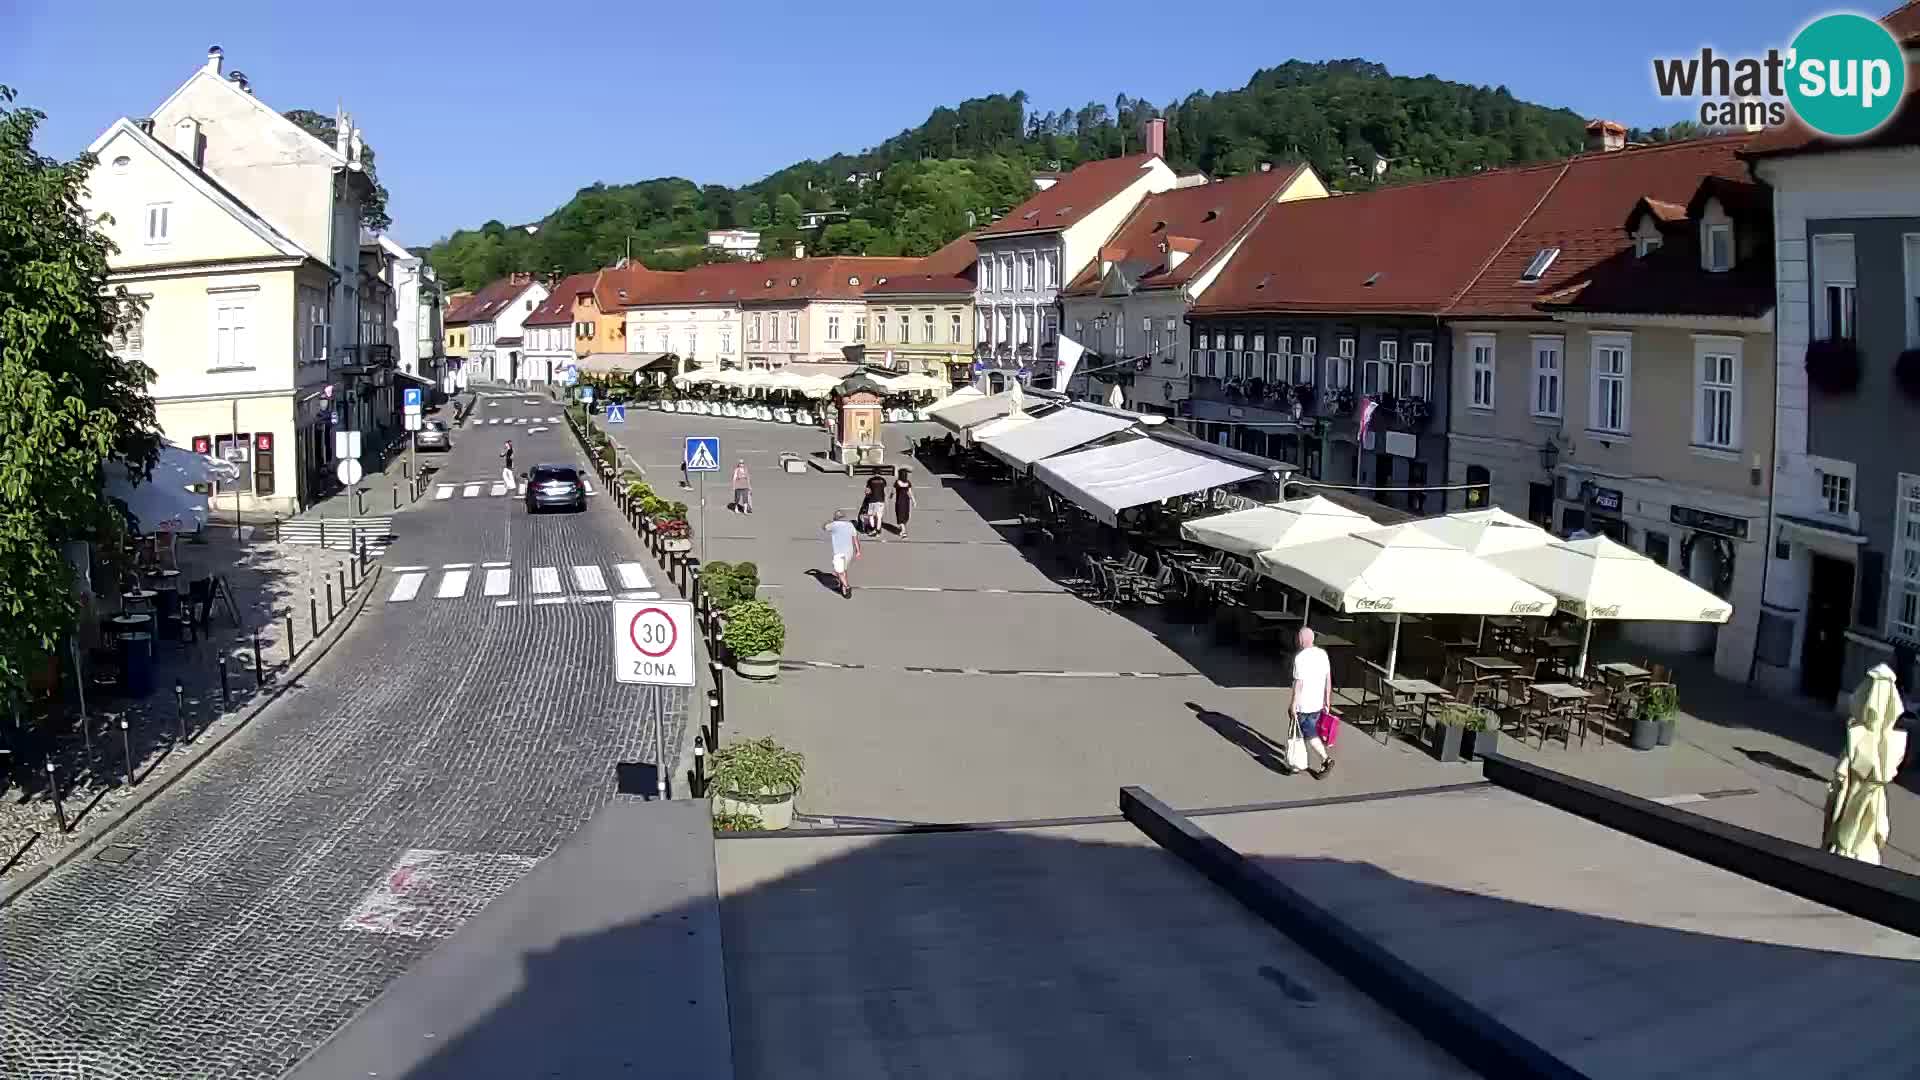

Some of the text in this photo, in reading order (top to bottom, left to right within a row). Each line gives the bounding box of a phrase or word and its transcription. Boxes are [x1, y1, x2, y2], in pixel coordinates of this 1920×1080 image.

[408, 392, 417, 403] P
[642, 623, 666, 644] 30
[633, 660, 676, 677] ZONA
